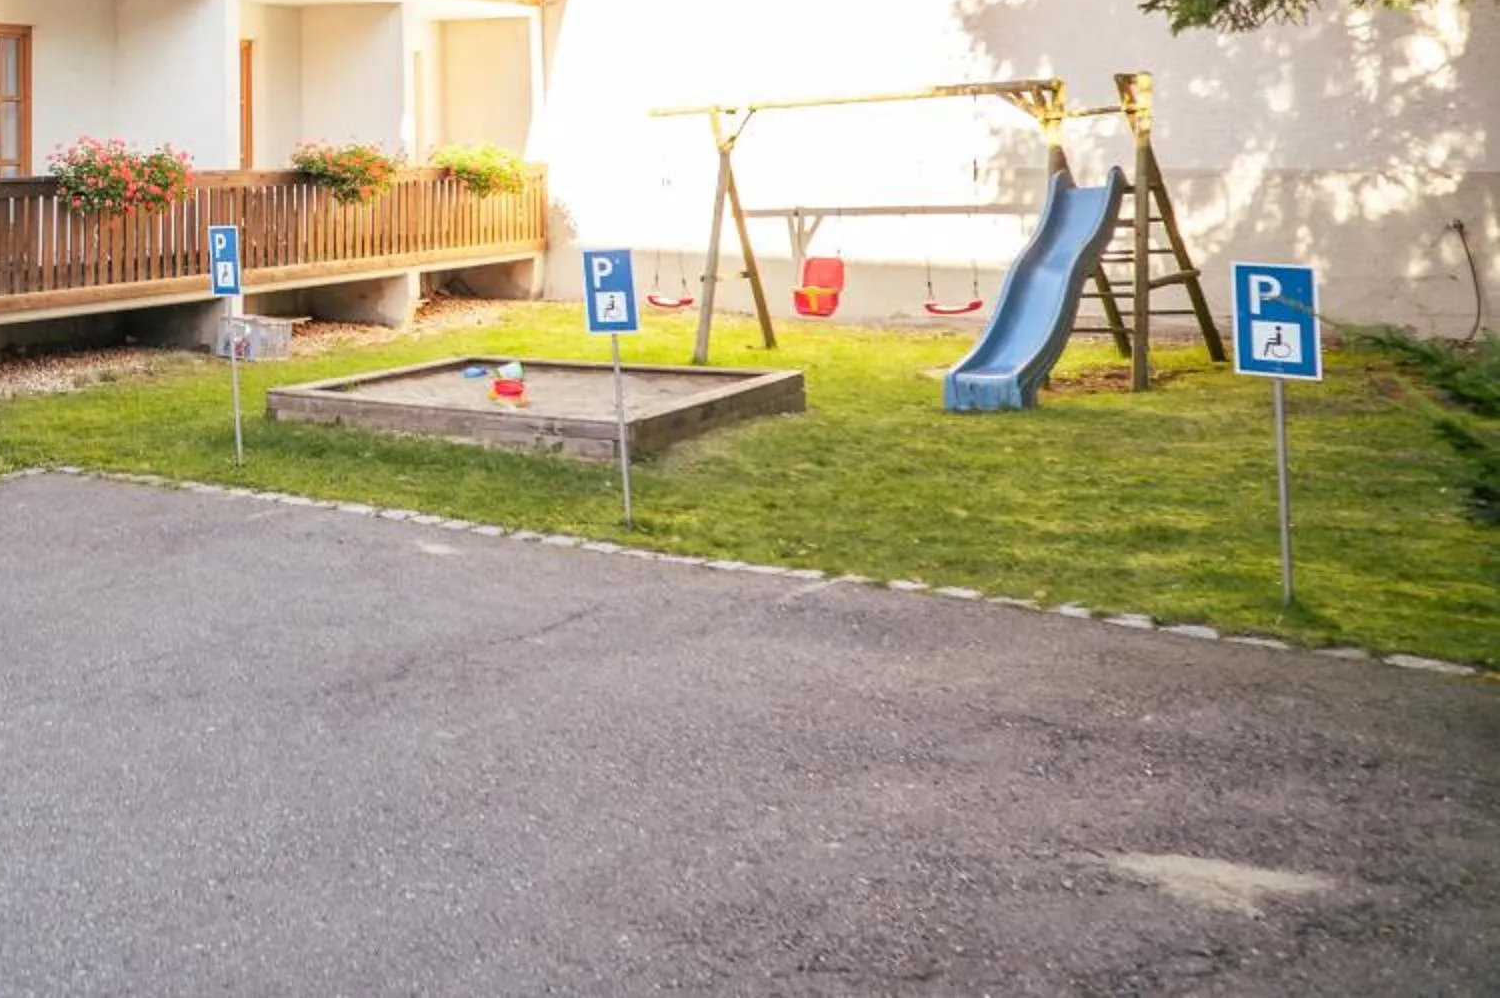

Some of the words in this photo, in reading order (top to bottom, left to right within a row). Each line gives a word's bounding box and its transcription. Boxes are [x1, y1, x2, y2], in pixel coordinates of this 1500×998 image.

[215, 233, 227, 258] P
[591, 257, 613, 289] P
[1248, 273, 1282, 315] P
